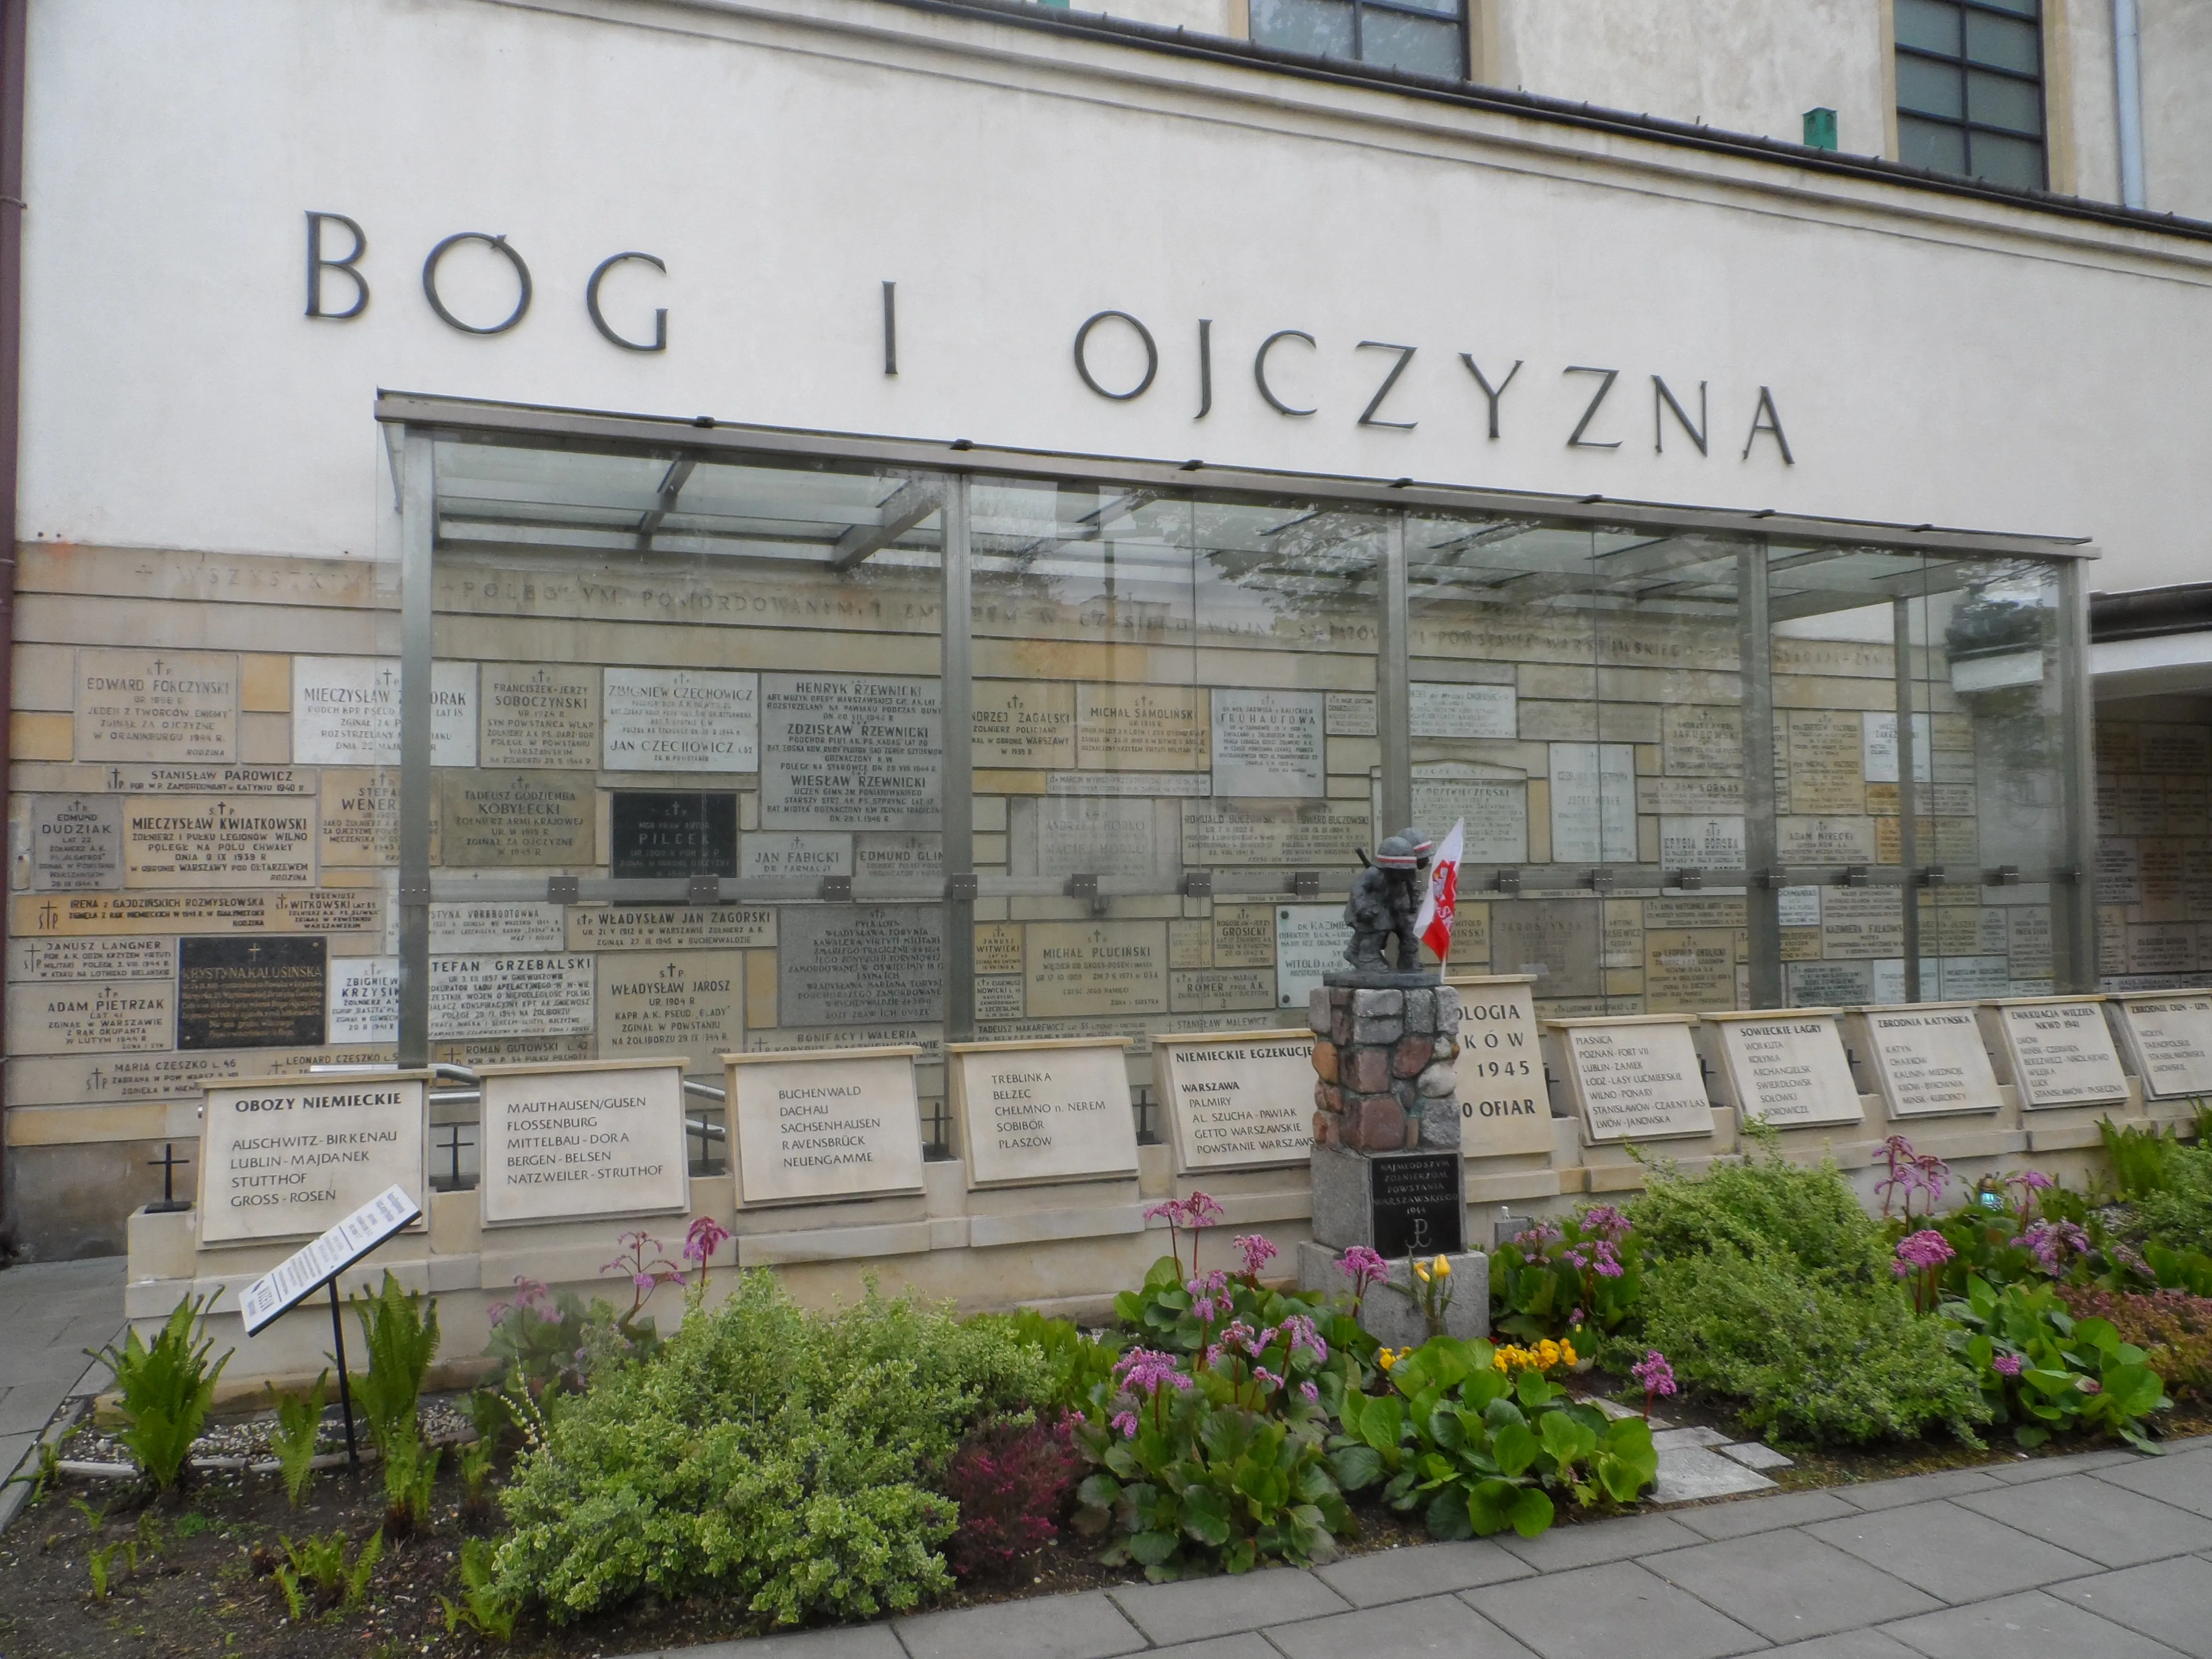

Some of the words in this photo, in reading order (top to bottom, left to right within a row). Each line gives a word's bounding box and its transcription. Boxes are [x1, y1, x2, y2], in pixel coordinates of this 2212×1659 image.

[882, 281, 898, 377] I
[1069, 311, 1795, 469] OJCZYZNA
[88, 677, 144, 691] EDWARD
[796, 683, 847, 694] HENRYK
[855, 684, 921, 696] RZEWNICKI
[673, 688, 752, 700] CZECHOWICZ
[788, 724, 853, 735] ZDZISŁAW
[862, 726, 928, 738] RZEWNICKI
[610, 740, 634, 751] JAN
[152, 771, 216, 780] STANISŁAW
[225, 771, 293, 781] PAROWICZ
[791, 775, 850, 786] WIESŁAW
[859, 776, 925, 788] RZEWNICKI
[478, 803, 559, 816] KOBYŁECKI
[42, 824, 111, 834] DUDZIAK
[133, 818, 213, 830] MIECZYSŁAW
[220, 818, 306, 830] KWIATKOWSKI
[755, 853, 779, 863] JAN
[788, 852, 838, 863] FABICKI
[860, 852, 910, 861] EDMUND
[71, 900, 98, 908] IRENA
[290, 901, 350, 909] WITKOWSKI
[599, 913, 674, 925] WŁADYSŁAW
[682, 913, 703, 923] JAN
[1223, 927, 1265, 939] GROSICKI
[102, 941, 161, 950] LANGNER
[1044, 948, 1083, 959] MICHAŁ
[495, 959, 589, 971] GRZEBALSKI
[611, 982, 684, 995] WŁADYSŁAW
[693, 980, 730, 991] JAROSZ
[48, 1002, 88, 1012] ADAM
[96, 999, 163, 1011] PIETRZAK
[2131, 1005, 2168, 1014] ZBRODNIE
[2011, 1010, 2059, 1019] EWAKUACJA
[1878, 1018, 1922, 1028] ZBRODNIA
[1924, 1016, 1970, 1025] KATYŃSKA
[2035, 1021, 2060, 1029] NKWD
[978, 1025, 1012, 1033] TADEUSZ
[1740, 1026, 1792, 1036] SOWIECKIE
[797, 1032, 855, 1043] BONIFACY
[867, 1030, 917, 1039] WALERIA
[466, 1045, 500, 1054] ROMAN
[507, 1040, 558, 1053] GUTOWSKI
[1745, 1041, 1784, 1050] WORKUTA
[334, 1054, 380, 1065] CZESZKO
[1176, 1050, 1246, 1062] NIEMIECKIE
[1250, 1047, 1312, 1058] EGZEKUCJE
[115, 1063, 150, 1072] MARIA
[156, 1060, 207, 1070] CZESZKO
[1478, 1060, 1529, 1077] 1945
[1754, 1066, 1812, 1076] ARCHANGIELSK
[991, 1073, 1052, 1084] TREBLINKA
[779, 1086, 861, 1099] BUCHENWALD
[1181, 1082, 1240, 1092] WARSZAWA
[236, 1098, 295, 1112] OBOZY
[303, 1093, 401, 1109] NIEMIECKIE
[507, 1097, 645, 1113] MAUTHAUSEN/GUSEN
[1068, 1101, 1105, 1111] NEREM
[1189, 1097, 1231, 1108] PALMIRY
[1479, 1099, 1536, 1117] OFIAR
[1689, 1099, 1705, 1108] LAS
[780, 1105, 828, 1117] DACHAU
[507, 1117, 597, 1131] FLOSSENBURG
[781, 1118, 880, 1133] SACHSENHAUSEN
[997, 1119, 1044, 1132] SOBIBÓR
[1195, 1129, 1227, 1139] GETTO
[1230, 1123, 1302, 1136] WARSZAWSKIE
[782, 1135, 865, 1150] RAVENSBRÜCK
[1197, 1142, 1256, 1154] POWSTANIE
[1259, 1137, 1314, 1150] WARSZAWS
[784, 1152, 873, 1167] NEUENGAMME
[1381, 1161, 1450, 1172] NAJMŁODSZYM
[232, 1173, 307, 1188] STUTTHOF
[1388, 1183, 1444, 1193] POWSTANIA
